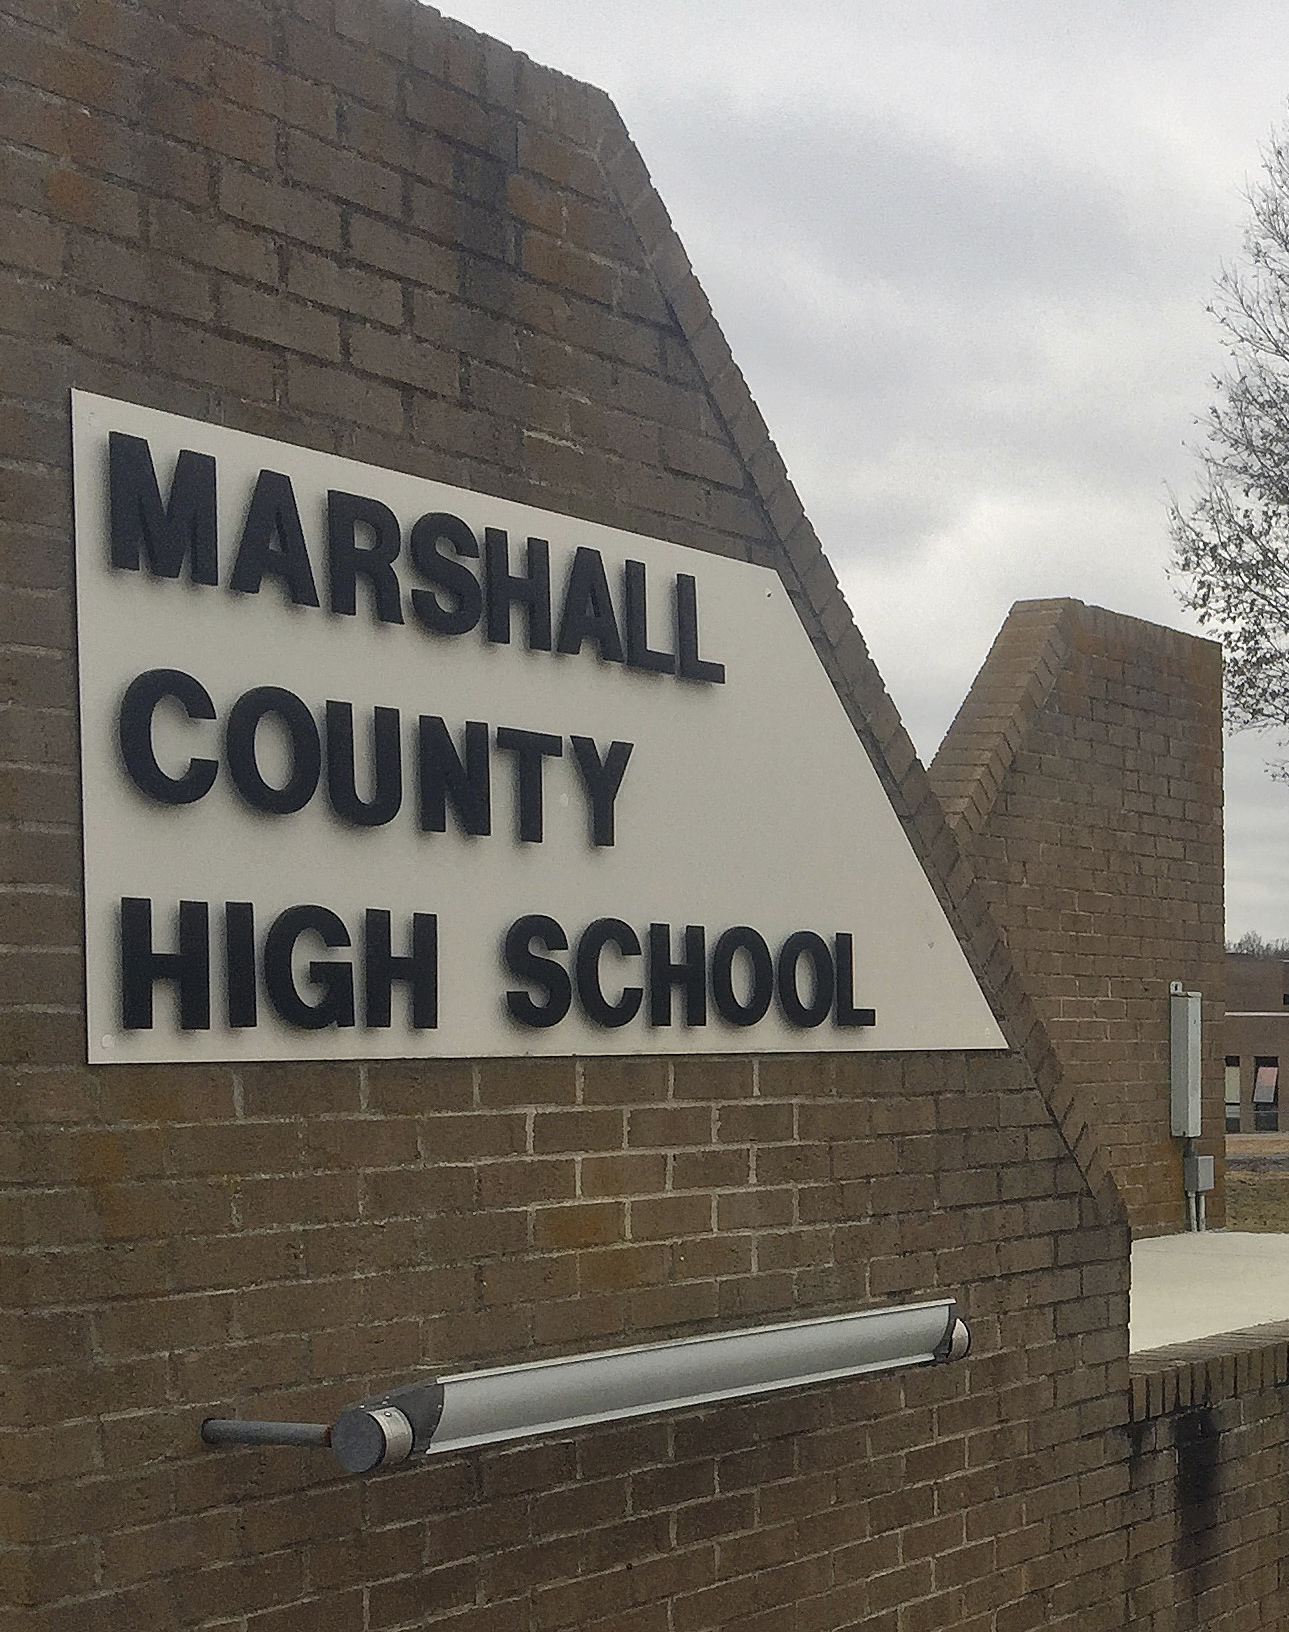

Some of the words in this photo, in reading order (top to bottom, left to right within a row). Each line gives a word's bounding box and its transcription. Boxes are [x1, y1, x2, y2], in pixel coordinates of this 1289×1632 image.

[106, 430, 726, 684] MARSHALL
[119, 668, 634, 847] COUNTY
[120, 897, 438, 1030] HIGH
[504, 914, 876, 1028] SCHOOL
